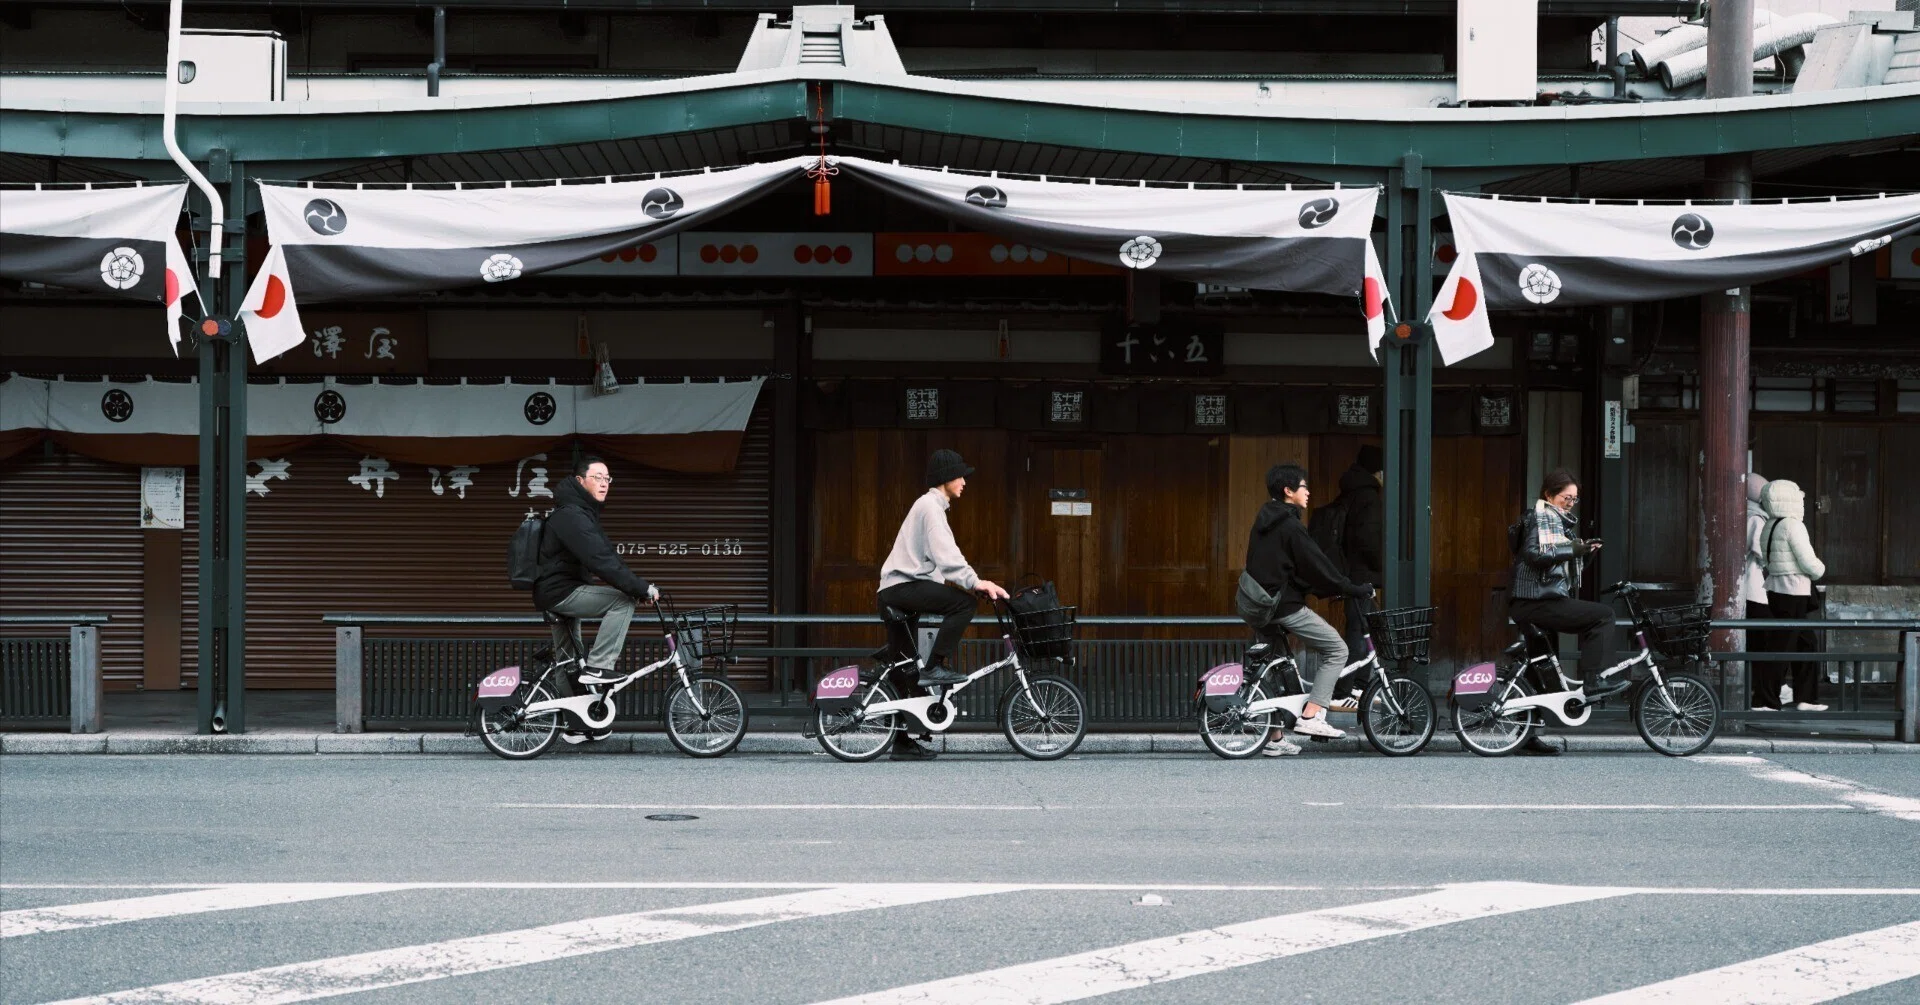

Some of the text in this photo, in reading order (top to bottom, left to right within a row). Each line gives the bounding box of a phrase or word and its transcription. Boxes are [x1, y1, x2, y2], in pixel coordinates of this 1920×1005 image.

[278, 325, 398, 360] 澤屋
[1116, 332, 1209, 365] 十六五
[616, 543, 742, 556] 075-525-0130
